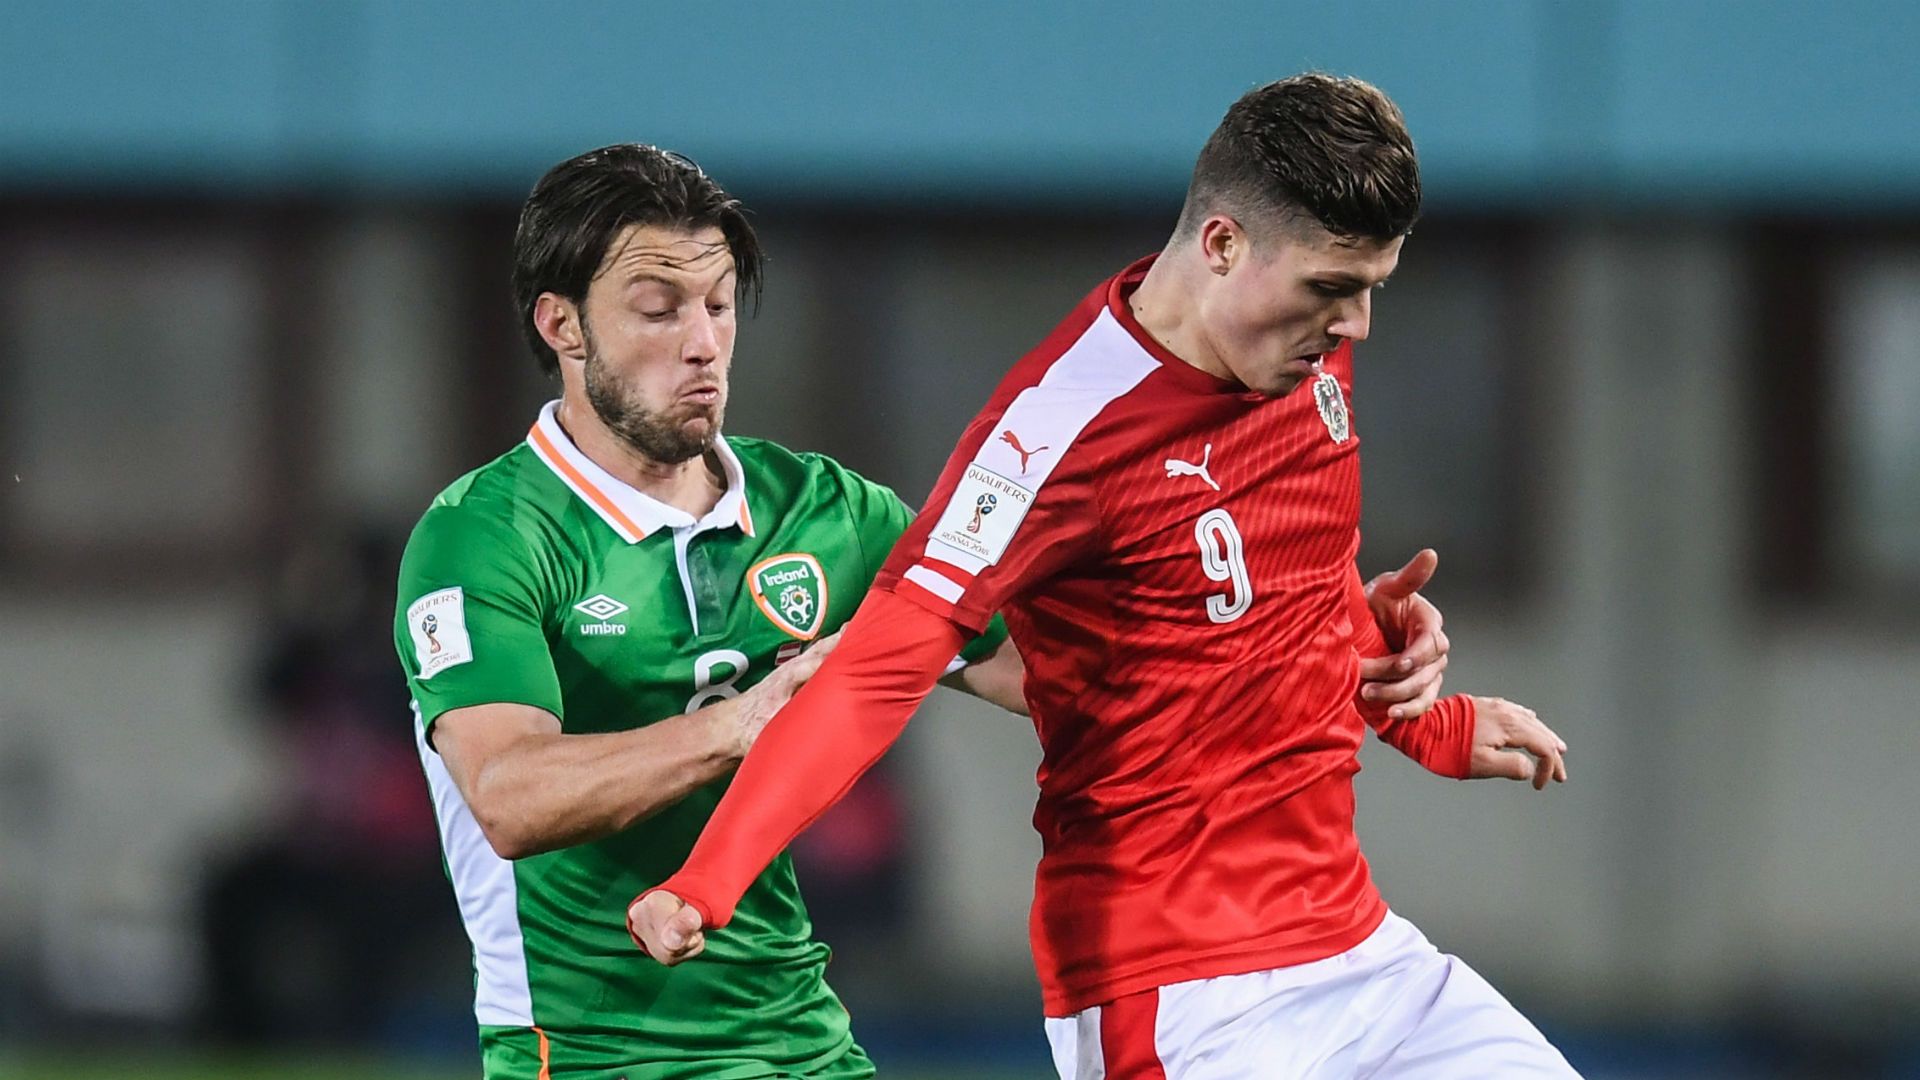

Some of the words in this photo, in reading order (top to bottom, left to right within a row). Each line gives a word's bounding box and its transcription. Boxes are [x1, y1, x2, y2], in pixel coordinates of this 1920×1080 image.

[968, 468, 1029, 504] QUALIFIERS
[763, 564, 809, 587] Ireland
[1194, 508, 1253, 624] 9
[580, 620, 626, 635] umbro
[684, 649, 749, 715] 8
